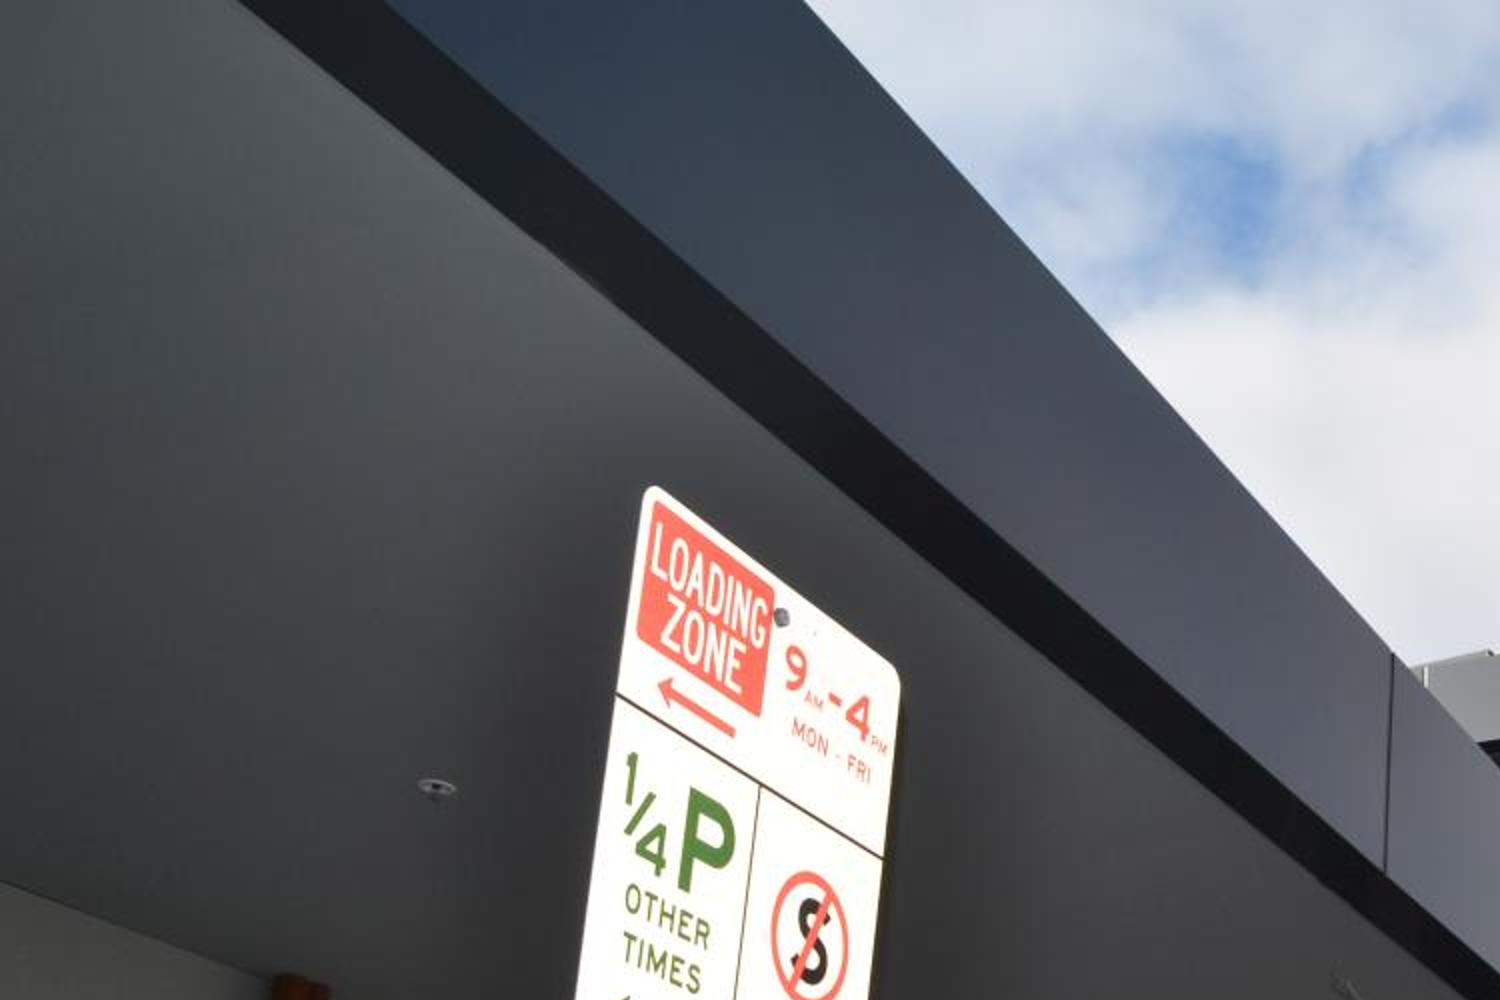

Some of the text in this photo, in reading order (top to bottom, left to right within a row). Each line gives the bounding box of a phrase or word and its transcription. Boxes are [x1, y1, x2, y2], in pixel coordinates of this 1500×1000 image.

[650, 520, 769, 650] LOADING
[660, 593, 747, 695] ZONE
[791, 717, 830, 757] MON
[846, 753, 873, 784] FRI
[624, 882, 712, 951] OTHER
[622, 930, 702, 995] TIMES
